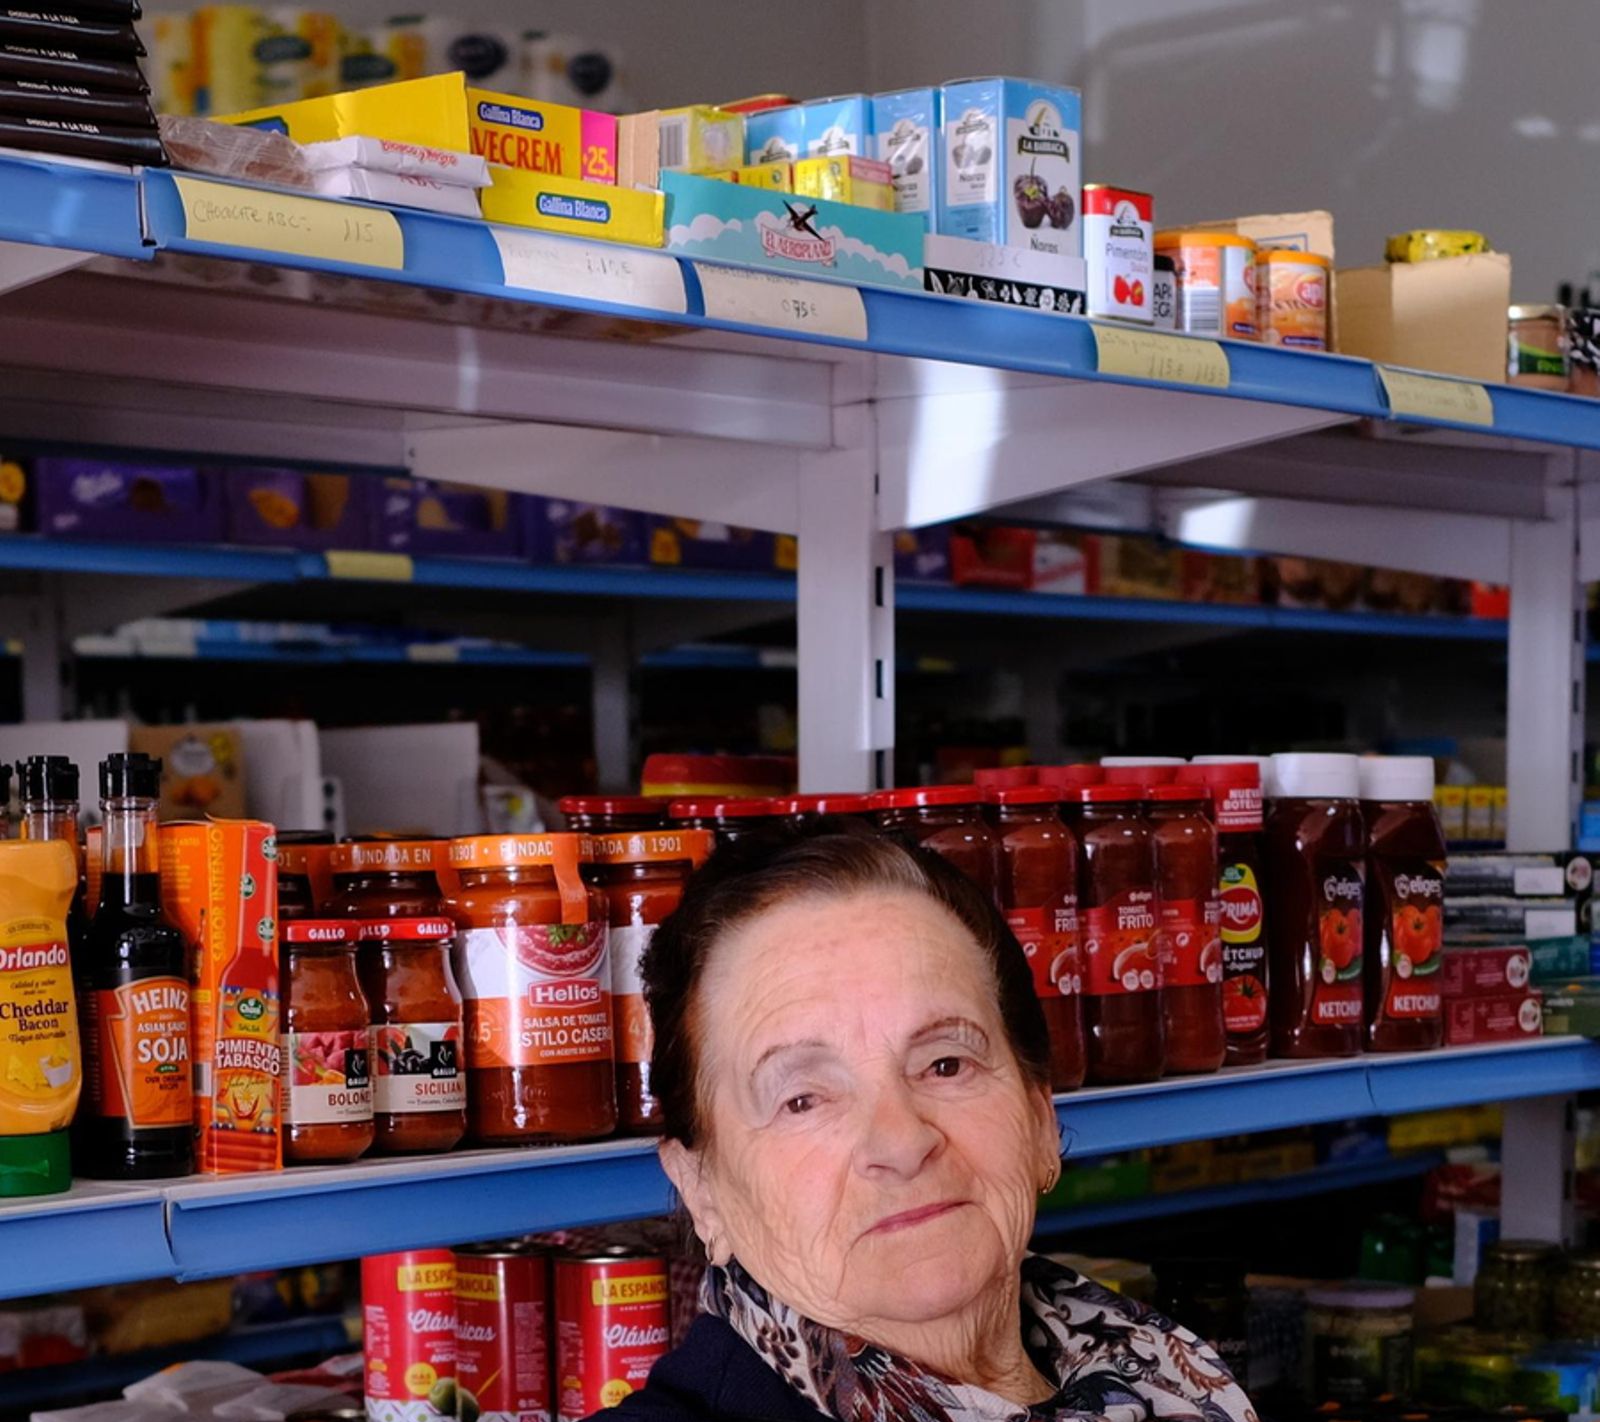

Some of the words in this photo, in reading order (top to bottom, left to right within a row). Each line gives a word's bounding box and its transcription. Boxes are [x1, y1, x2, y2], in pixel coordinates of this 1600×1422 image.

[480, 103, 511, 124] Gallina
[512, 109, 541, 129] Blanca
[539, 193, 574, 217] Gallina
[575, 200, 608, 222] Blanca
[765, 231, 776, 248] EL
[651, 835, 683, 853] 1901
[414, 847, 431, 863] EN
[416, 922, 449, 935] GALLO
[1117, 913, 1154, 930] FRITO
[308, 928, 345, 940] GALLO
[131, 986, 188, 1015] HEINZ
[535, 985, 599, 1004] Helios
[0, 998, 70, 1020] Cheddar
[18, 1018, 59, 1032] Bacon
[138, 1022, 165, 1033] ASIAN
[523, 1016, 560, 1029] SALSA
[562, 1016, 577, 1027] DE
[137, 1037, 188, 1063] SOJA
[215, 1038, 281, 1063] PIMIENTA
[215, 1052, 281, 1076] TABASCO
